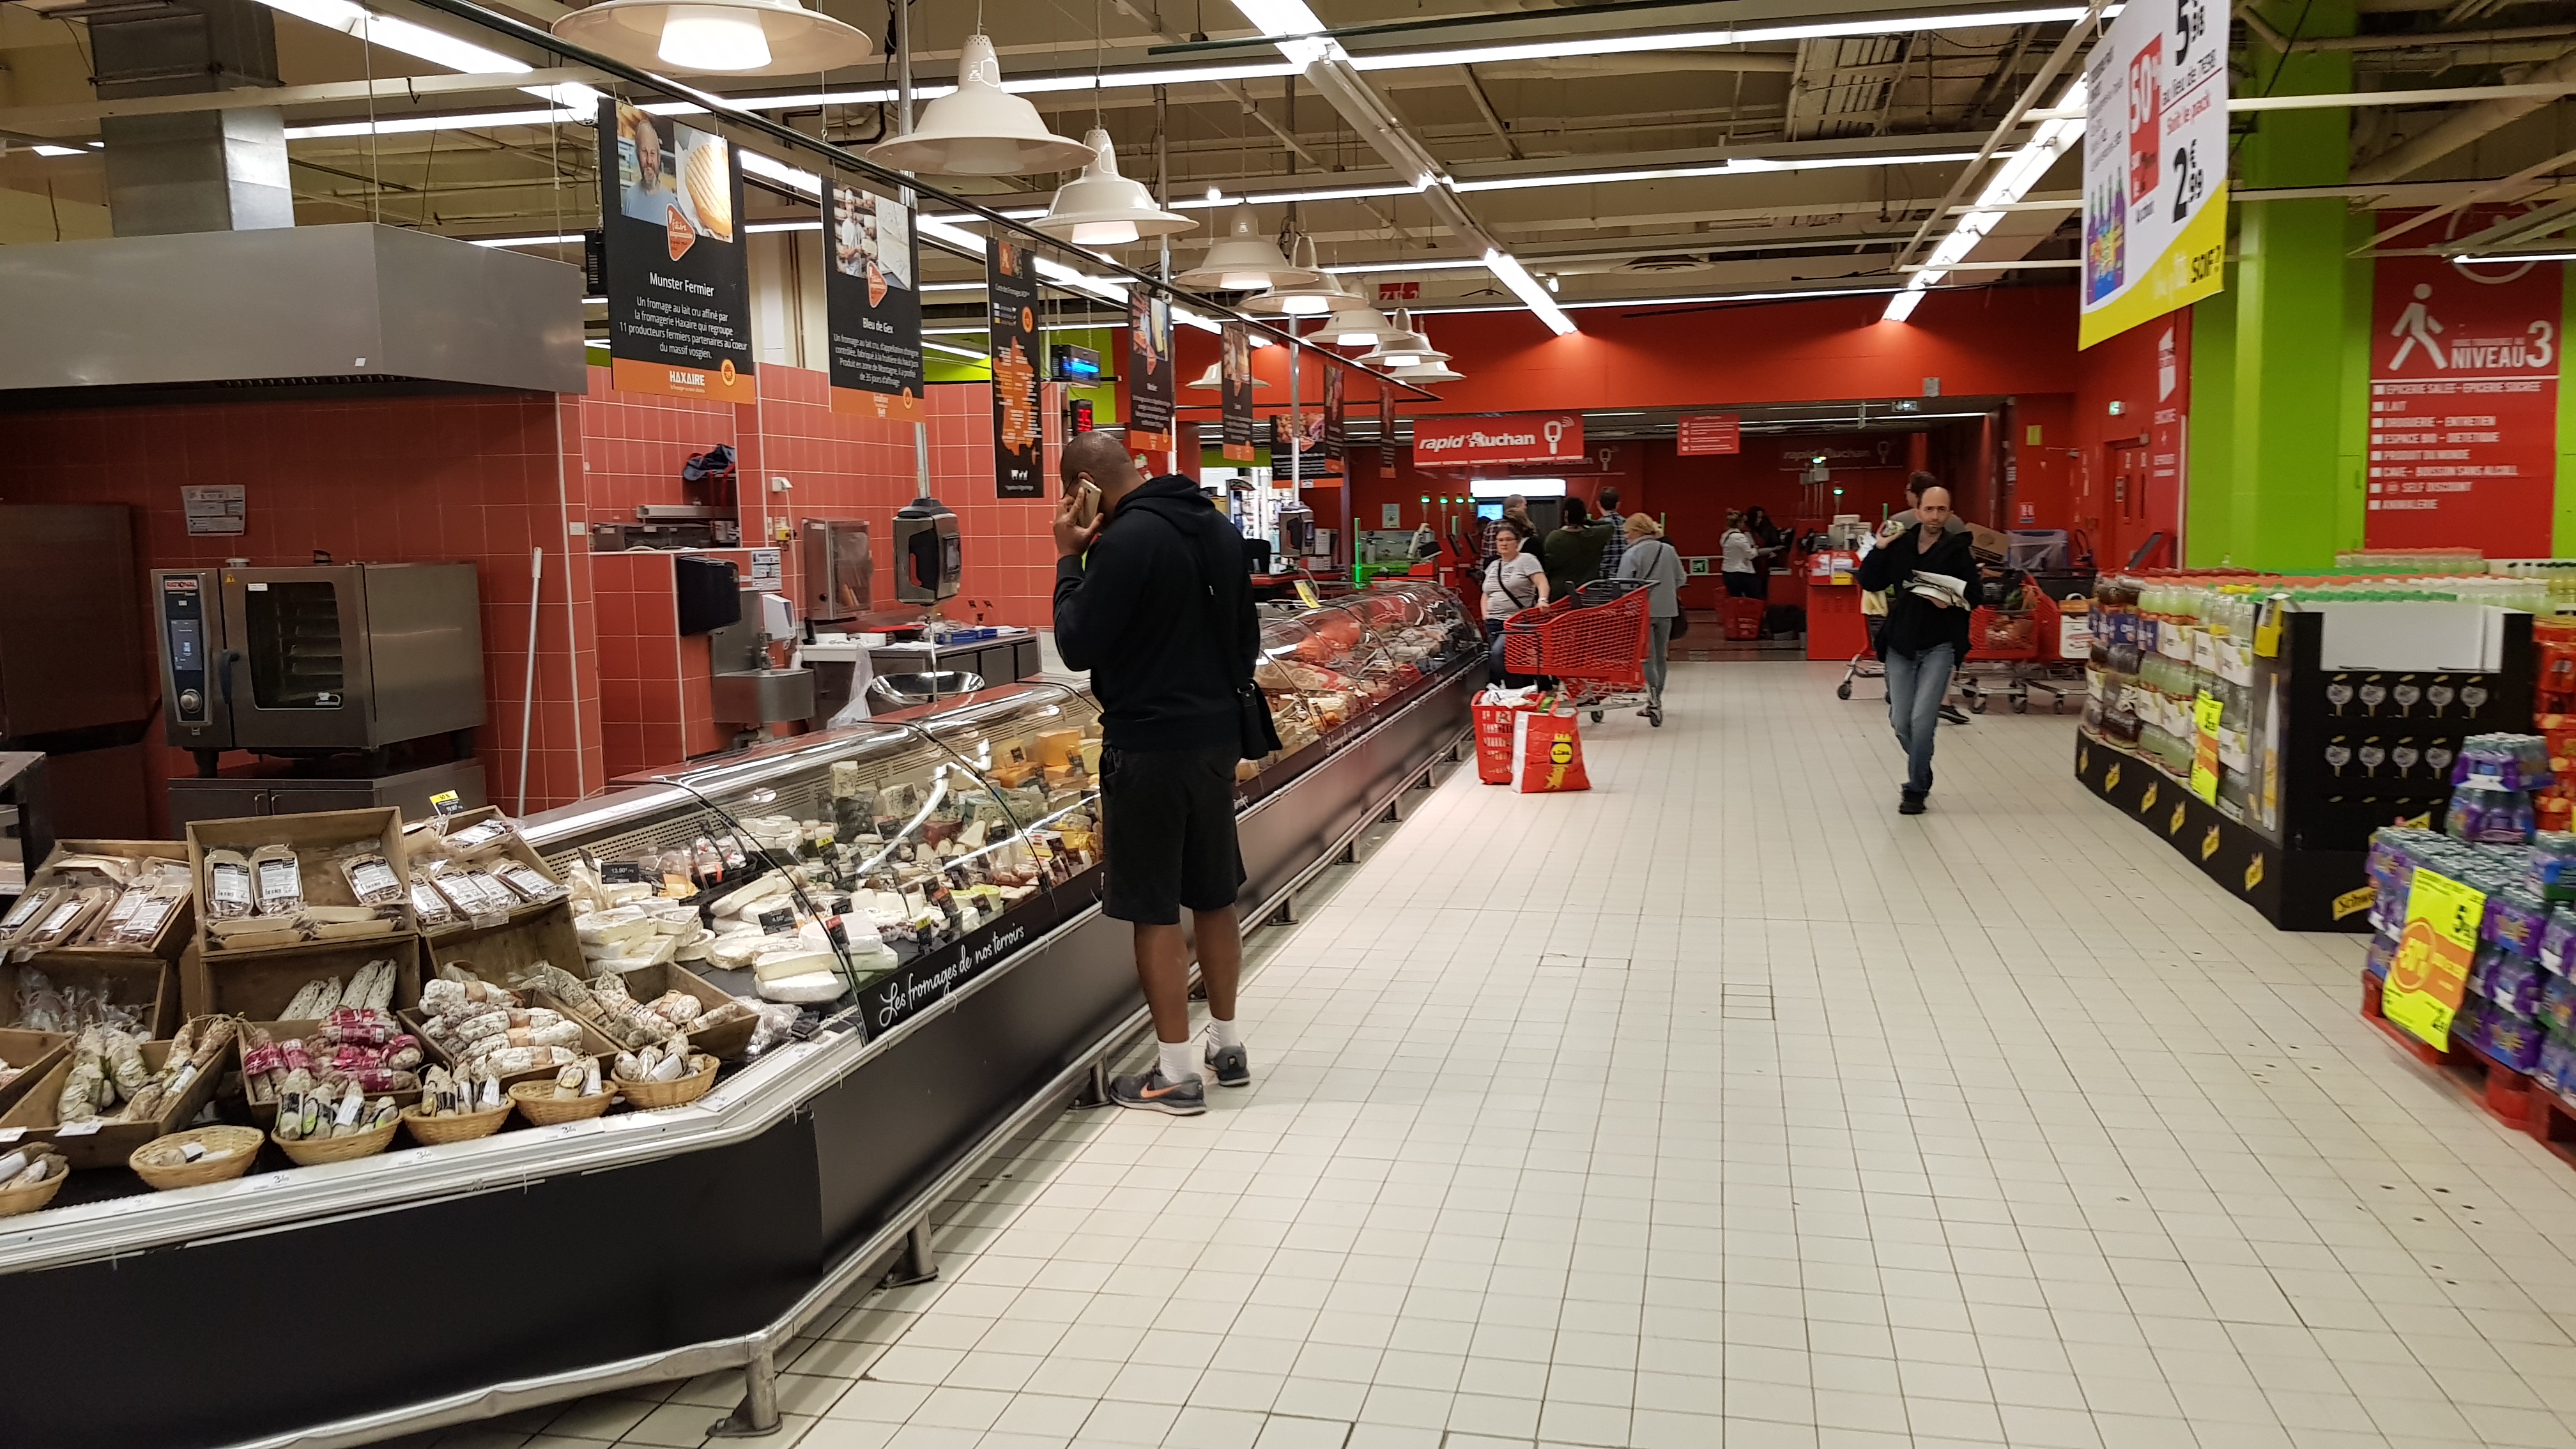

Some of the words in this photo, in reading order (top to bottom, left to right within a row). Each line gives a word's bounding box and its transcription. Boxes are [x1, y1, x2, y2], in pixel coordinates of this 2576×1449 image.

[650, 272, 683, 290] Munster
[684, 279, 714, 296] Fermier
[634, 309, 641, 319] la
[641, 310, 674, 326] fromagerie
[675, 317, 697, 330] Haxaire
[698, 323, 707, 333] qui
[708, 325, 733, 336] regroupe
[636, 296, 646, 307] Un
[647, 297, 672, 314] fromage
[673, 305, 680, 313] au
[681, 303, 690, 315] lait
[691, 308, 701, 317] cru
[702, 309, 717, 320] affiné
[718, 312, 728, 323] par
[619, 321, 627, 332] 11
[629, 325, 666, 338] producteurs
[666, 328, 691, 342] fermiers
[691, 335, 723, 348] partenaires
[724, 340, 732, 348] au
[862, 318, 875, 330] Bleu
[876, 320, 883, 332] de
[883, 323, 894, 334] Gex
[659, 342, 668, 352] du
[669, 344, 688, 355] massif
[2451, 346, 2526, 369] NIVEAU
[2526, 319, 2554, 368] 3
[670, 370, 705, 386] HAXAIRE
[879, 982, 906, 1027] Les
[908, 964, 958, 1009] fromages
[959, 944, 972, 974] de
[975, 944, 992, 964] nos
[992, 923, 1025, 954] terroirs
